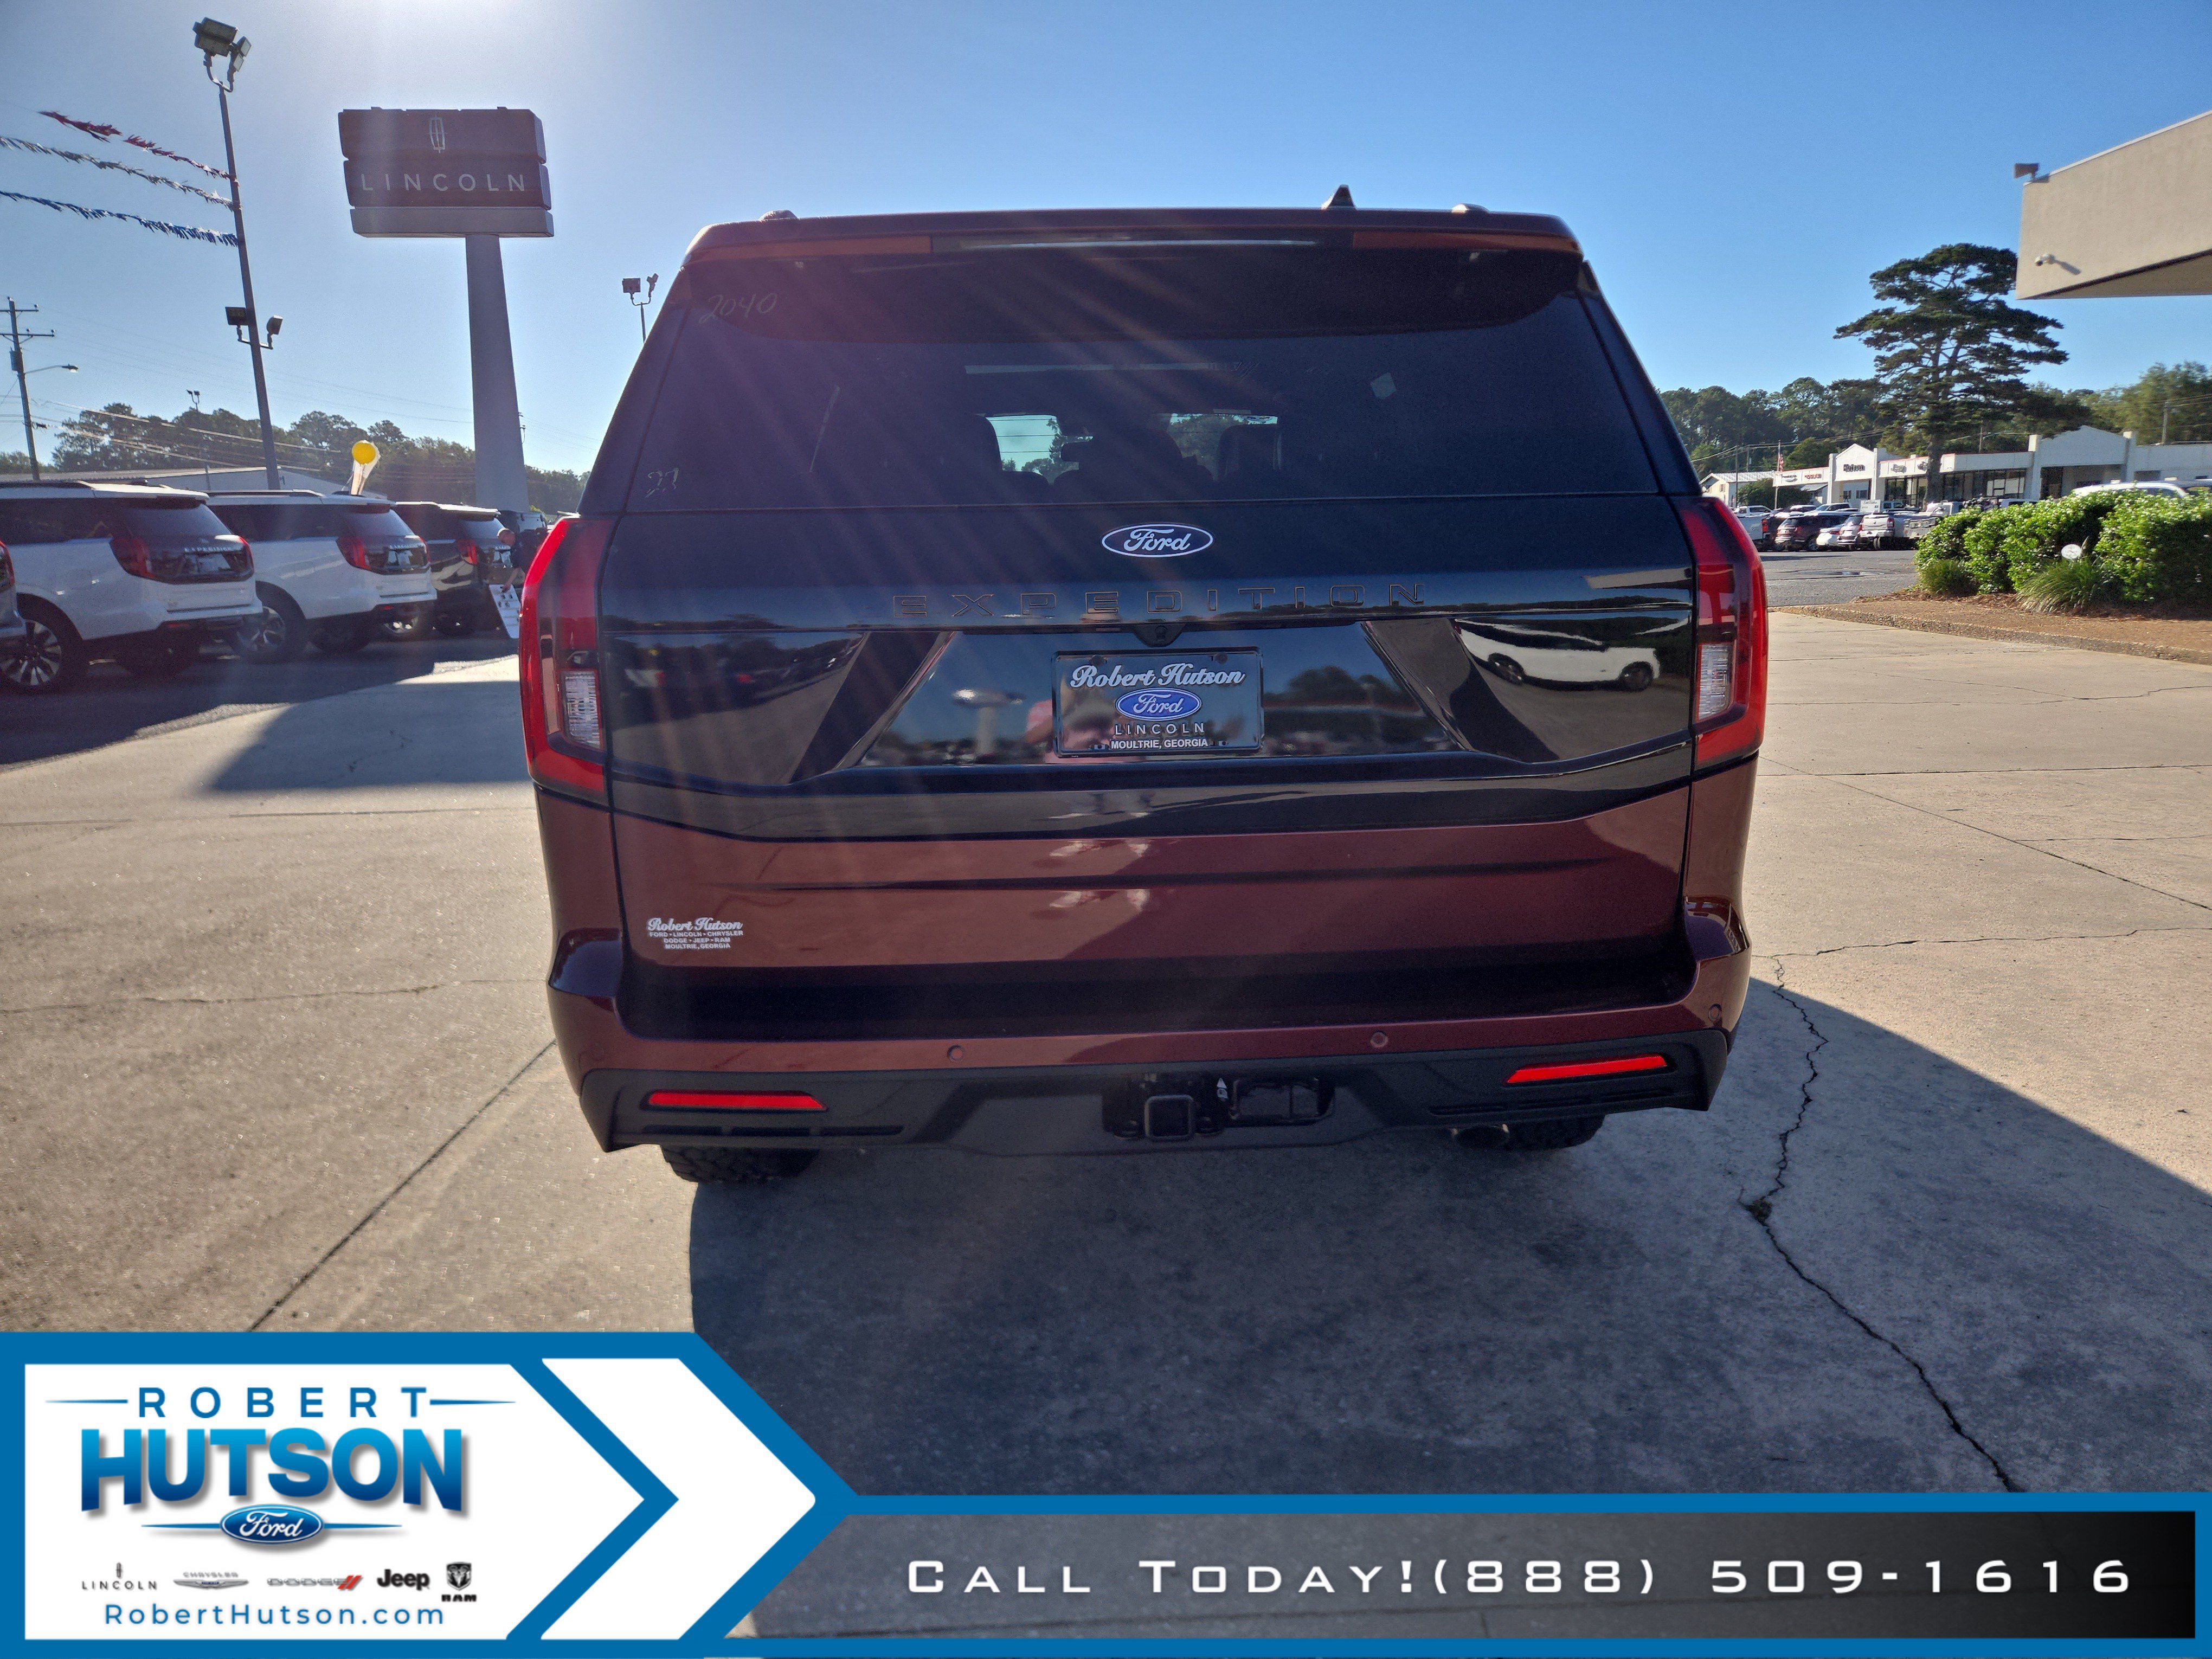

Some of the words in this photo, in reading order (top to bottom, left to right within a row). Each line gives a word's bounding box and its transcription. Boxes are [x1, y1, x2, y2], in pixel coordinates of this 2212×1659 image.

[361, 173, 525, 191] LINCOLN
[698, 292, 778, 324] 2040
[1123, 528, 1192, 552] Ford
[892, 582, 1426, 619] EXPEDITION
[1070, 665, 1156, 688] Robert
[1158, 663, 1246, 685] Hutson
[1133, 693, 1184, 714] Ford
[1114, 722, 1205, 735] LINCOLN
[1110, 740, 1162, 749] MOULTRIE,
[1163, 738, 1208, 748] GEORGIA
[647, 917, 693, 931] Robert
[694, 917, 743, 930] Hutson
